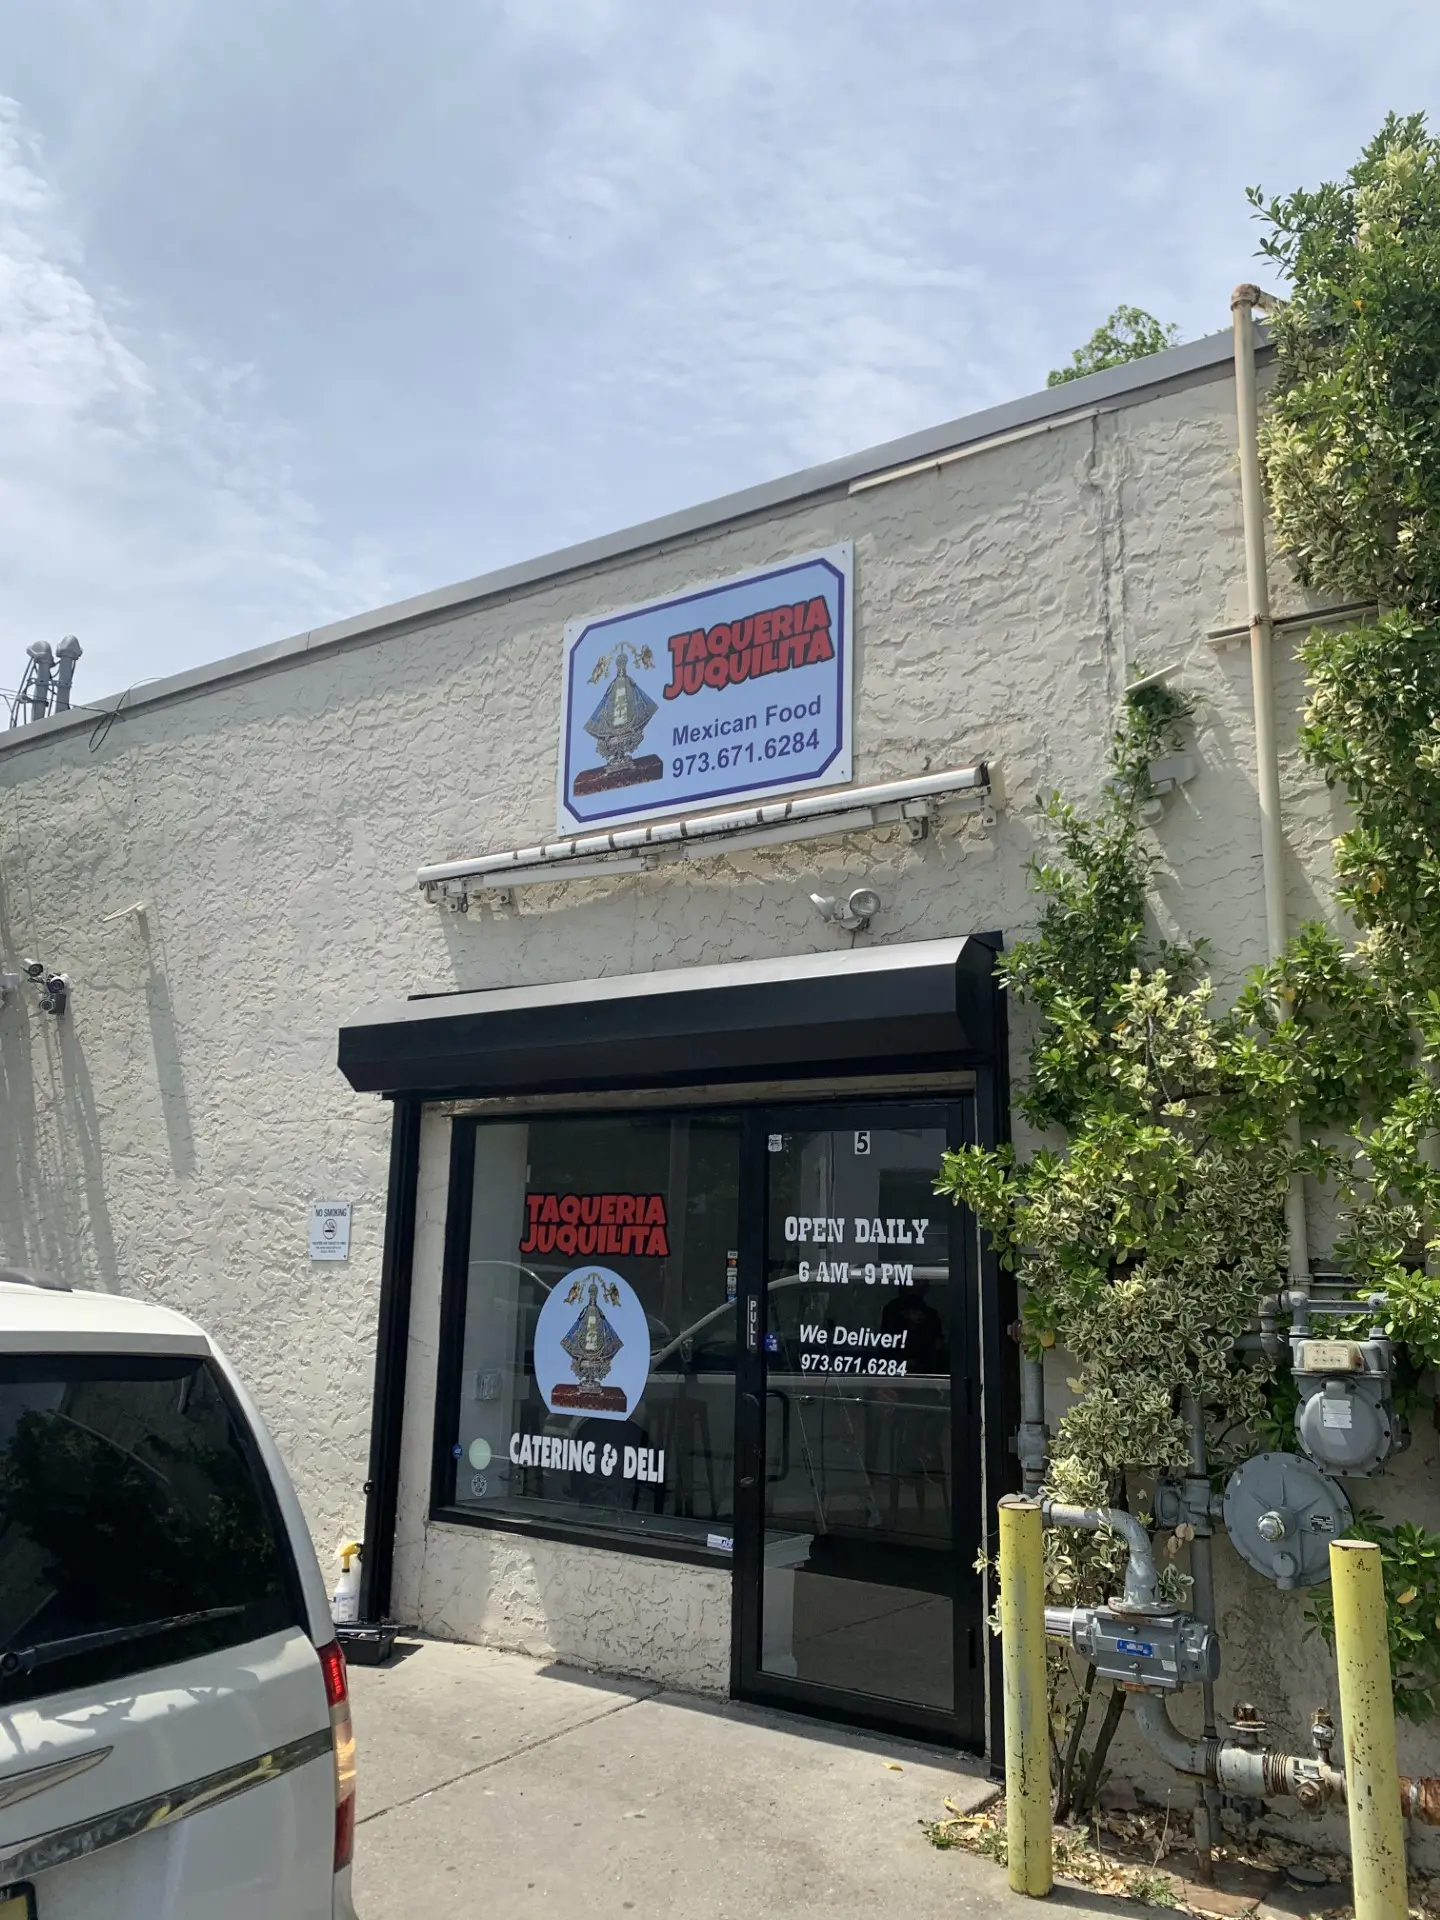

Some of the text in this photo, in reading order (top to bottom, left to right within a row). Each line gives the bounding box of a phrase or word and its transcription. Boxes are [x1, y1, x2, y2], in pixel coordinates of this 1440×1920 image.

[668, 595, 832, 667] TAQUERIA
[663, 629, 834, 700] JUQUILITA
[672, 695, 821, 746] Mexican Food
[672, 728, 820, 778] 973.671.6284
[856, 1131, 868, 1153] 5
[315, 1208, 347, 1217] NO SMOKING
[526, 1193, 666, 1225] TAQUERIA
[519, 1221, 670, 1257] JUQUILITA
[784, 1216, 929, 1244] OPEN DAILY
[798, 1261, 810, 1282] 6
[881, 1263, 914, 1286] PM
[799, 1324, 828, 1345] We
[833, 1325, 908, 1349] Deliver!
[800, 1354, 907, 1377] 973.671.6284
[509, 1432, 665, 1484] CATERING & DELI
